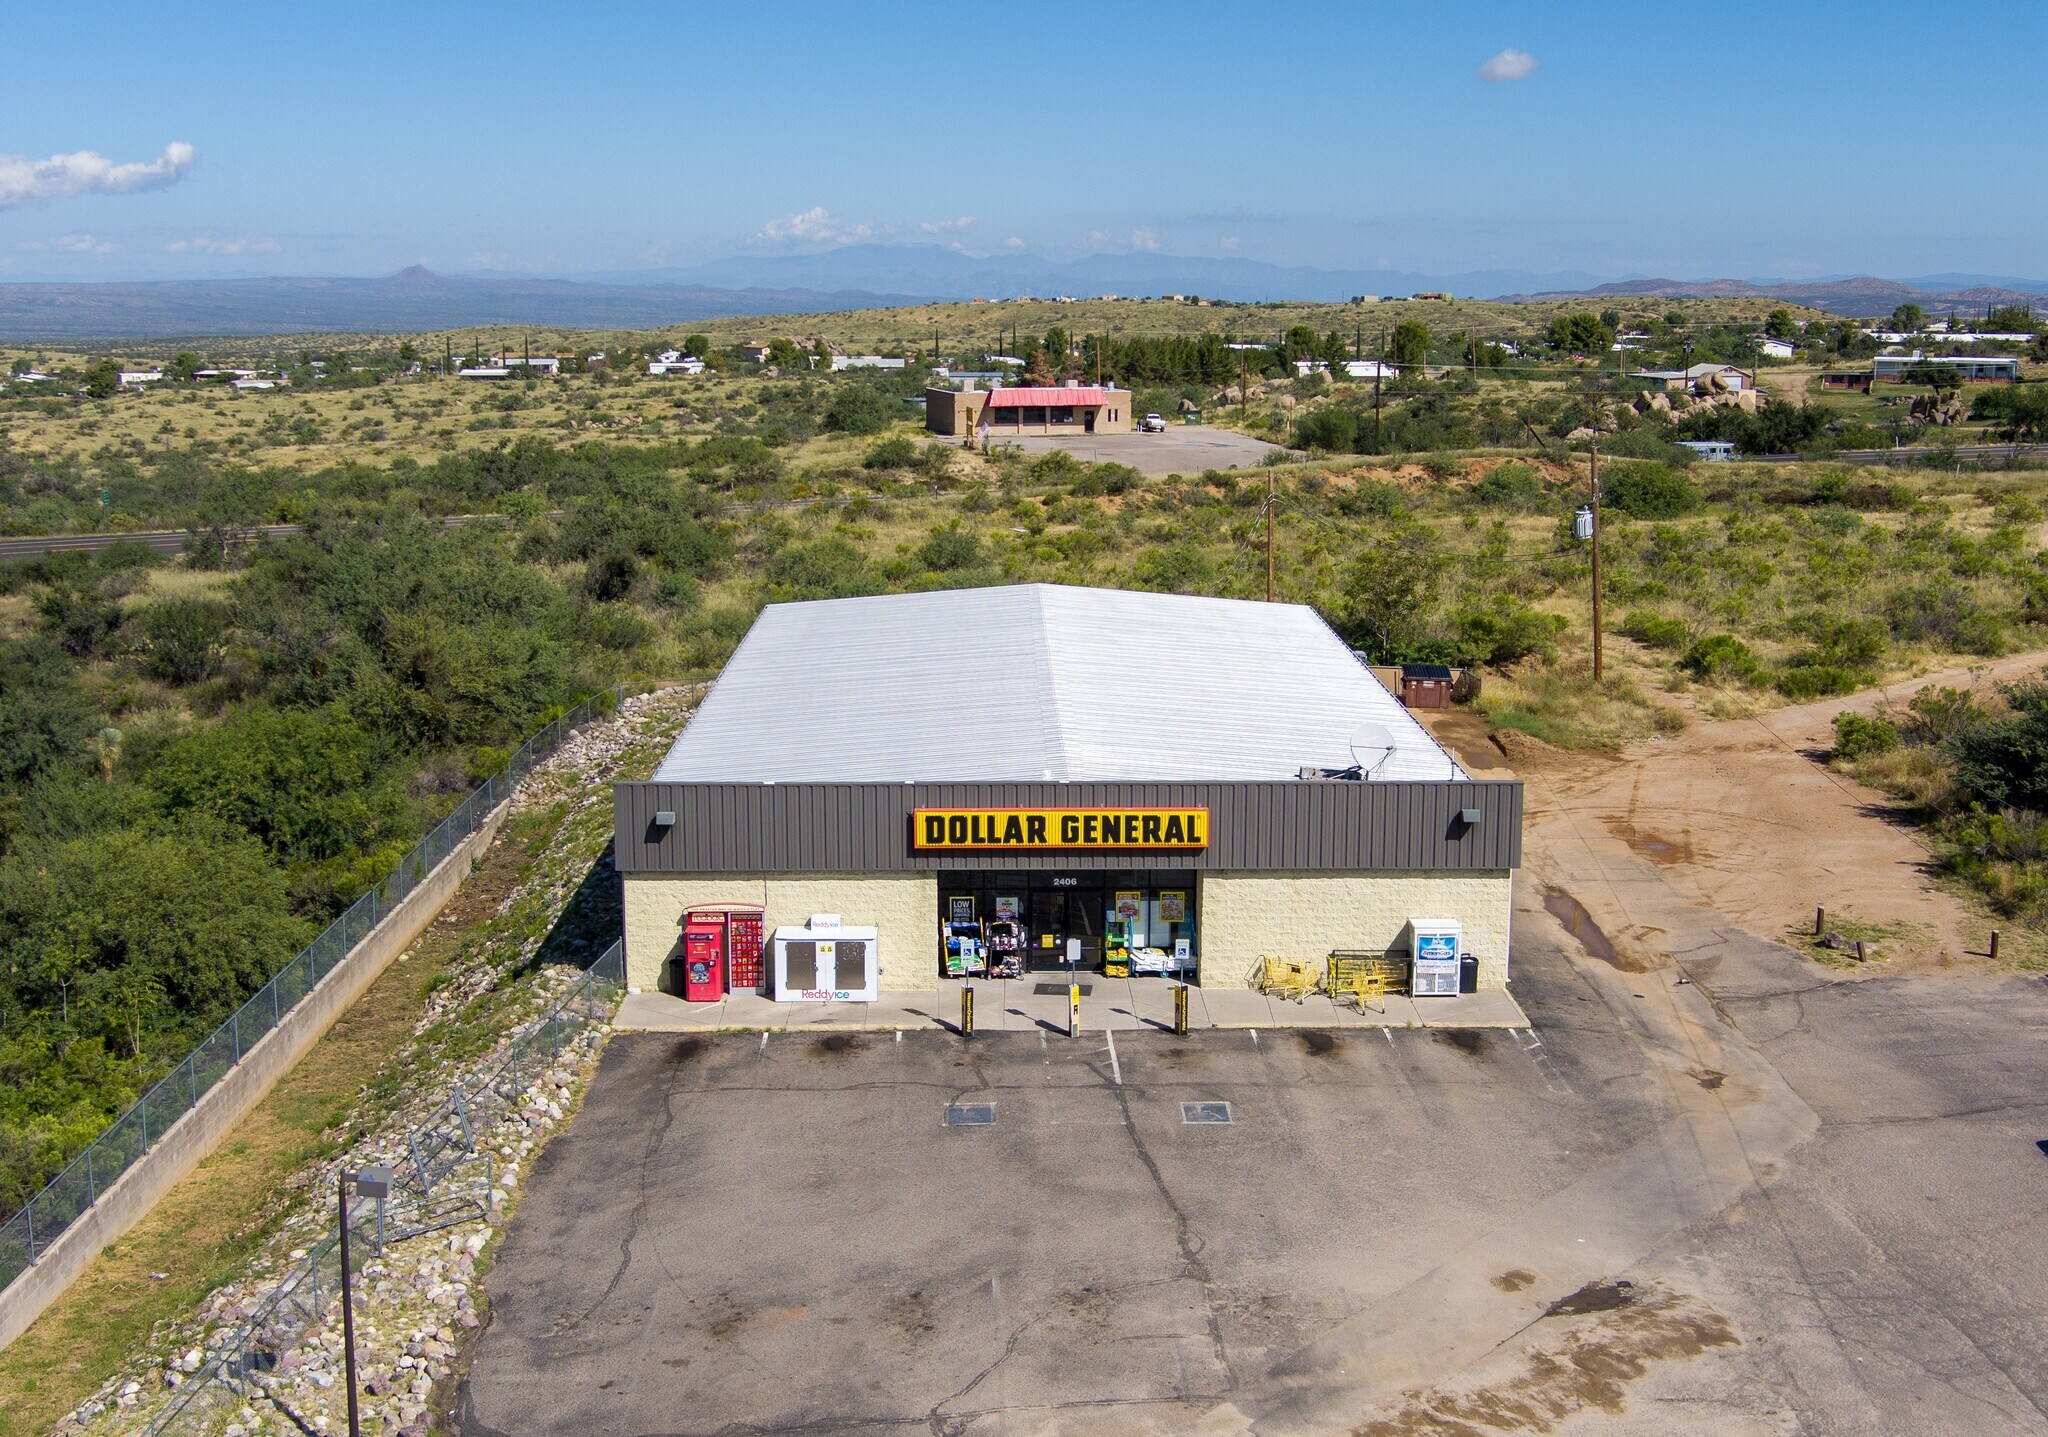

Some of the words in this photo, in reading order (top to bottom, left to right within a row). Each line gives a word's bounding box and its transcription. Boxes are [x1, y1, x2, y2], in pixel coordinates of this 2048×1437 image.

[925, 815, 1048, 845] DOLLAR
[1061, 815, 1201, 844] GENERAL
[1053, 877, 1077, 886] 2406
[953, 900, 970, 908] LOW
[801, 988, 850, 1001] Reddyice
